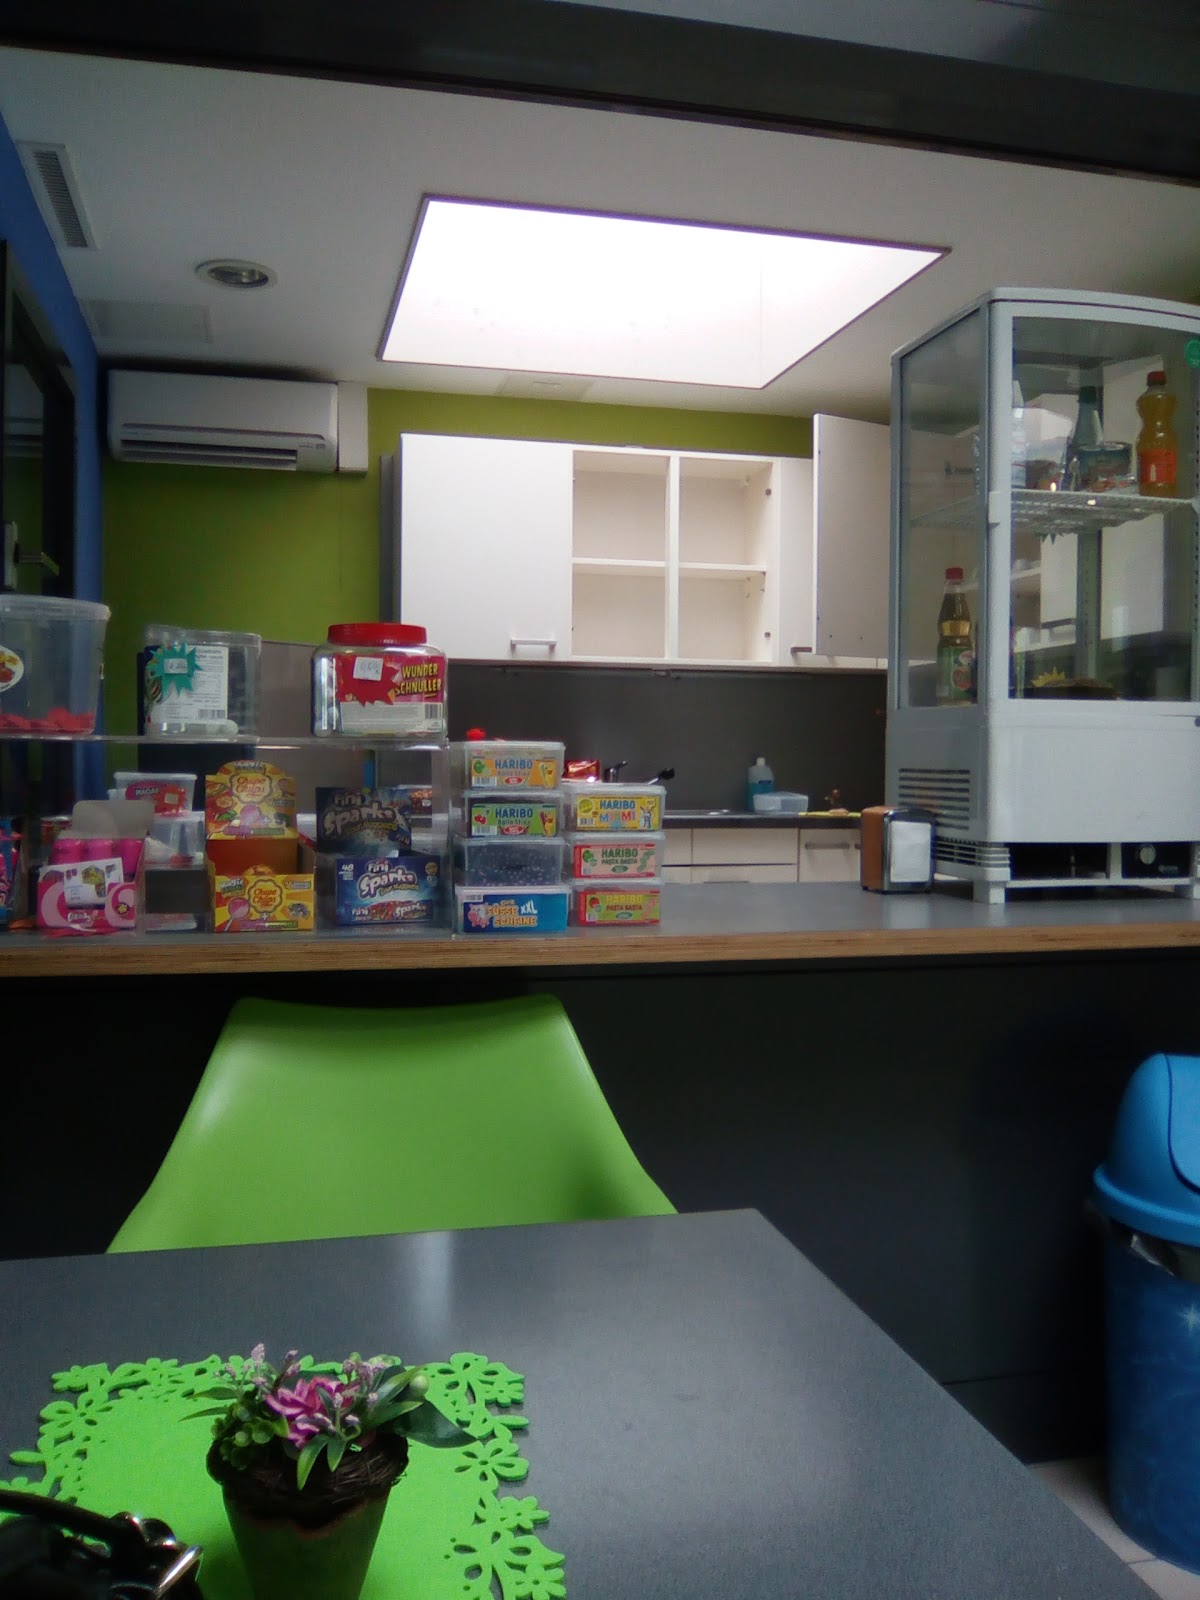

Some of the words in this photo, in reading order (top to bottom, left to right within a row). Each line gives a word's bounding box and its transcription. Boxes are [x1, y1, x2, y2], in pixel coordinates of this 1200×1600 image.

[402, 663, 438, 678] WUNDER
[395, 679, 441, 695] SCHNULLER
[494, 759, 533, 769] HARIBO
[599, 800, 636, 810] HARIBO
[495, 808, 534, 818] HARIBO
[601, 848, 639, 858] HARIBO
[606, 894, 643, 904] HARIBO
[520, 900, 538, 914] XXL
